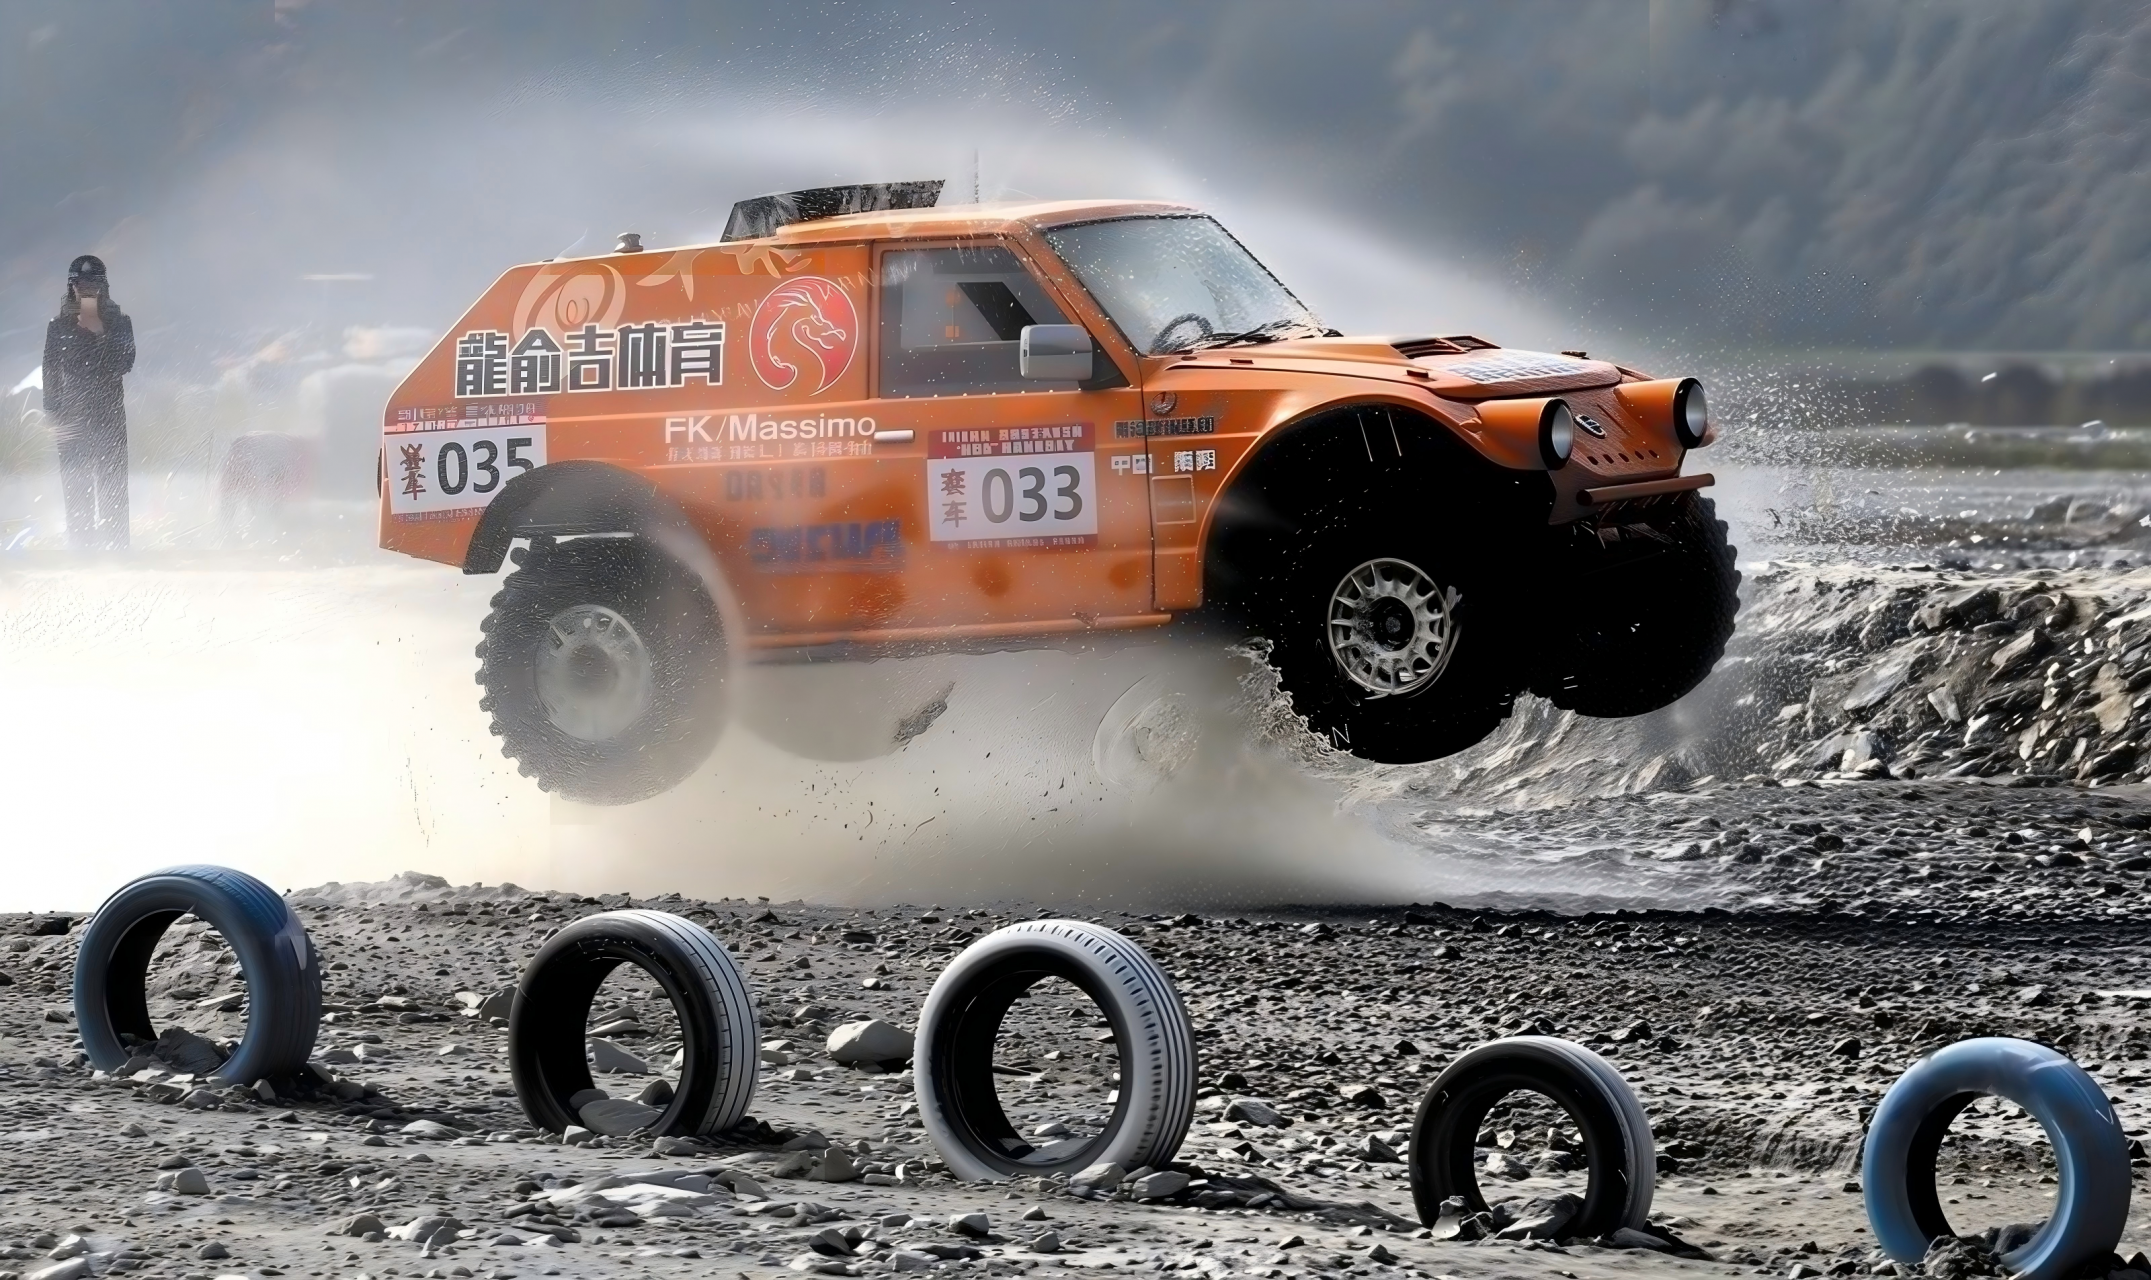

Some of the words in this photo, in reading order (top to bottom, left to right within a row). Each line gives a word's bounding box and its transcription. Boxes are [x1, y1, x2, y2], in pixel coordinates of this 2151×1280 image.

[665, 413, 876, 444] FK/Massimo
[437, 437, 535, 496] 035
[981, 464, 1083, 524] 033
